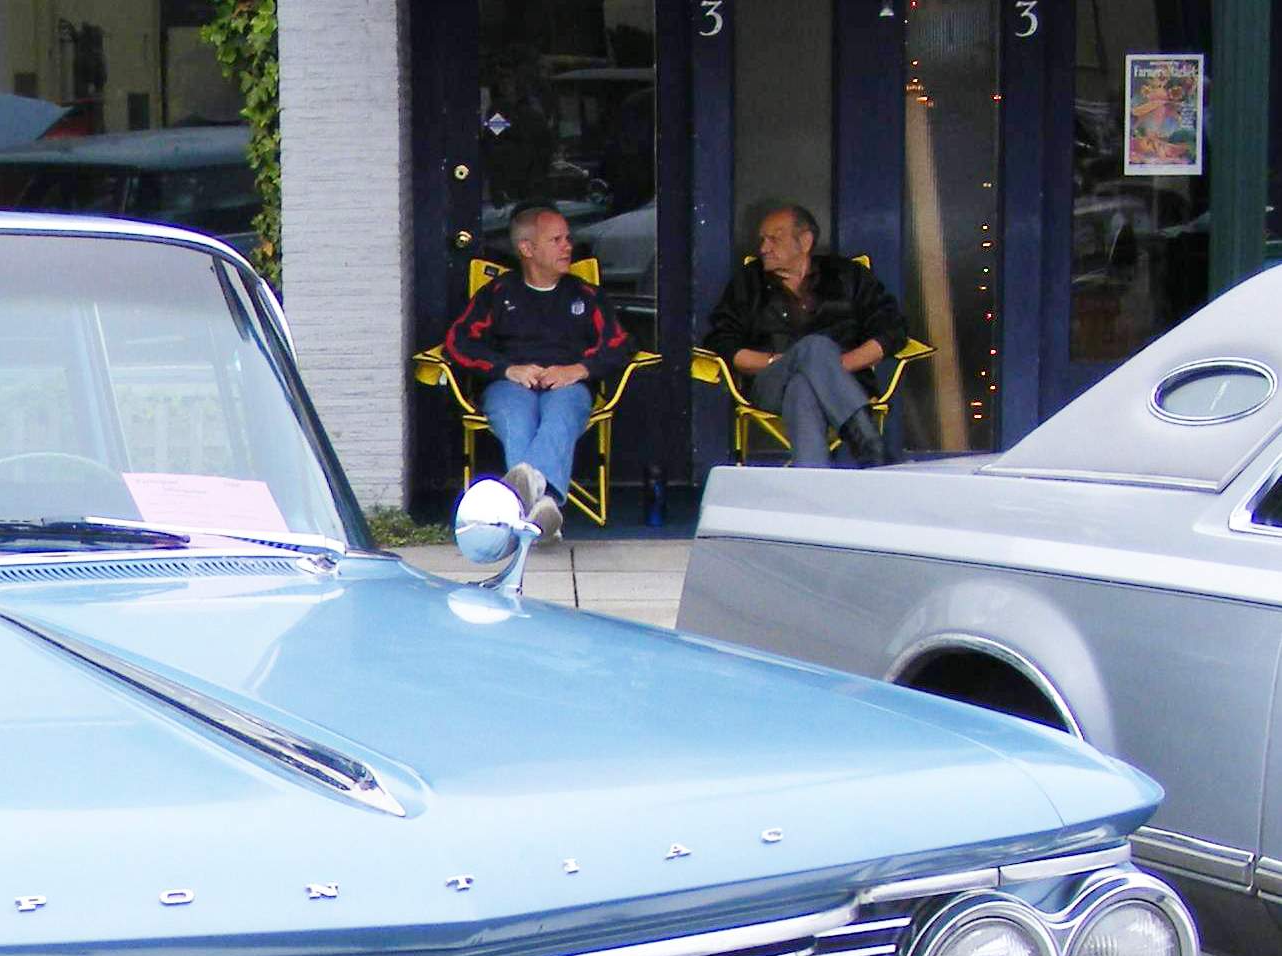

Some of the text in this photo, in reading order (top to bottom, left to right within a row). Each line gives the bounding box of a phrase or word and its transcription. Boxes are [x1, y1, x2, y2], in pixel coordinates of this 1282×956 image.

[700, 0, 723, 37] 3
[1015, 0, 1039, 38] 3
[15, 826, 783, 912] PONTIAC
